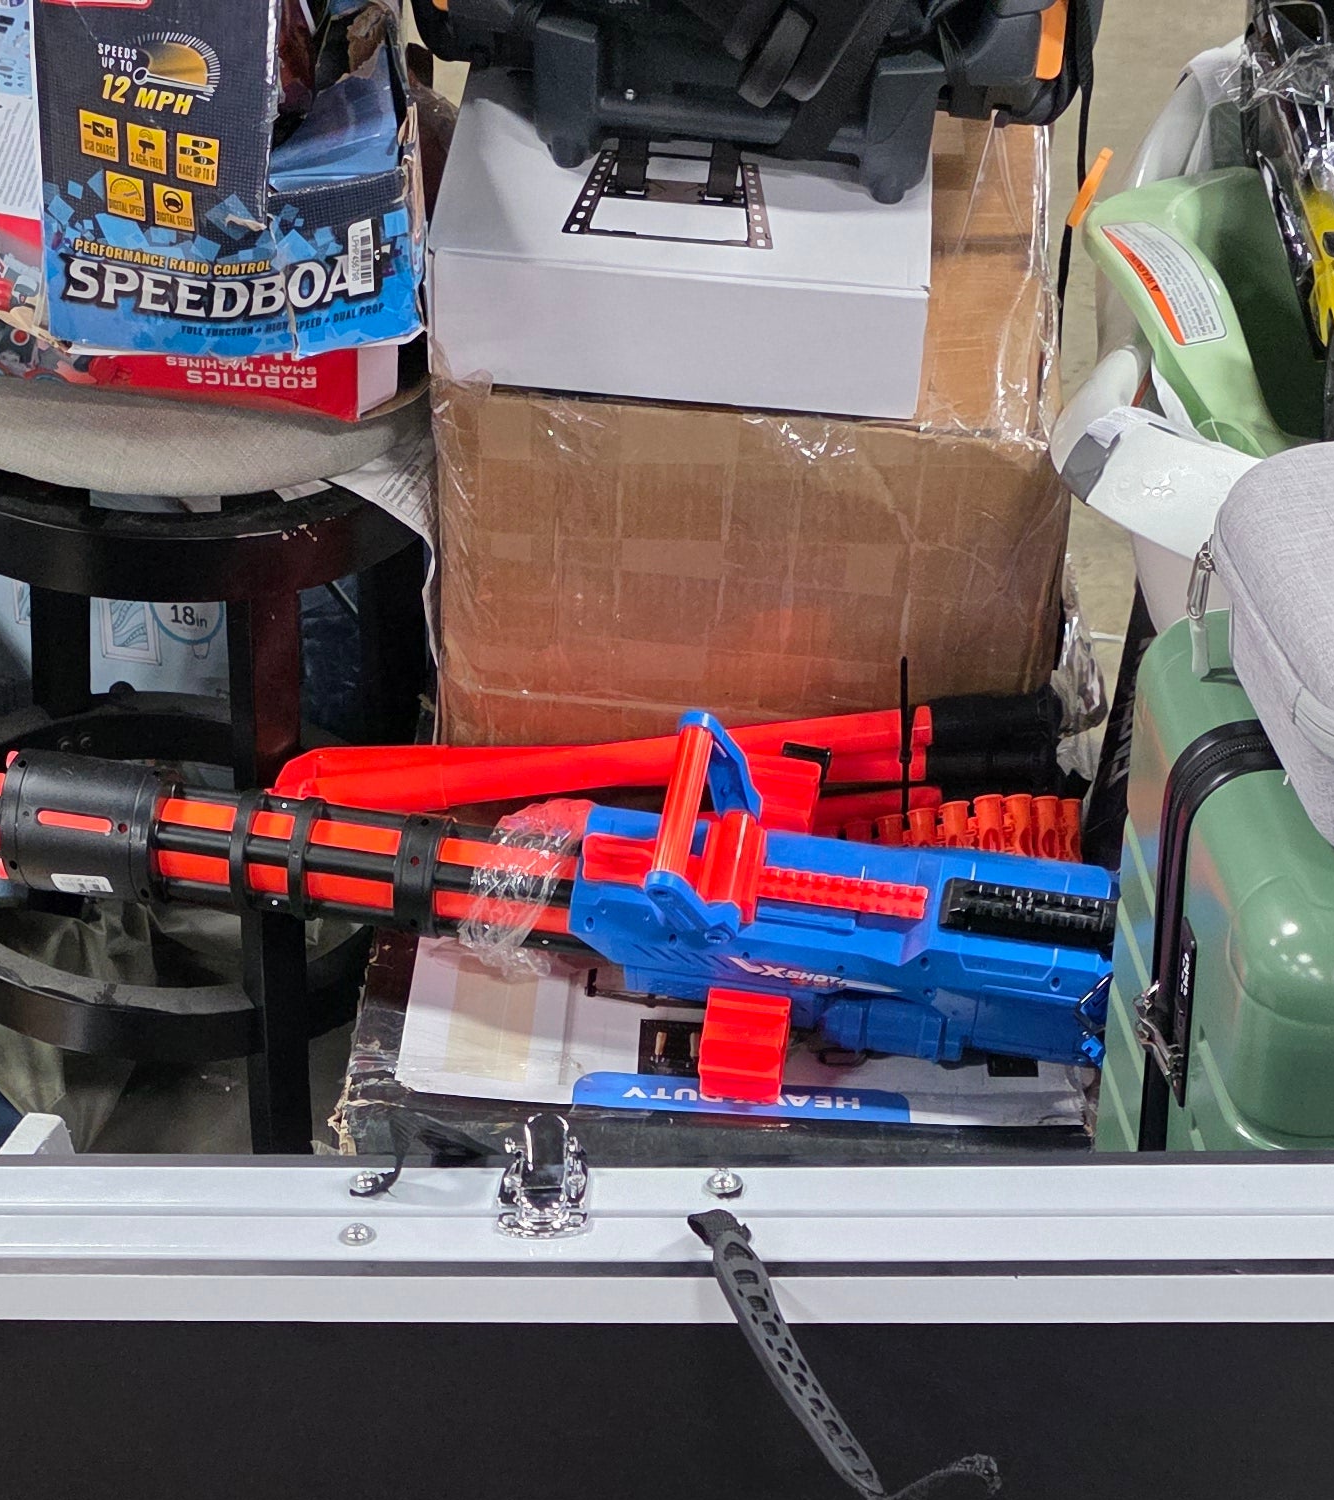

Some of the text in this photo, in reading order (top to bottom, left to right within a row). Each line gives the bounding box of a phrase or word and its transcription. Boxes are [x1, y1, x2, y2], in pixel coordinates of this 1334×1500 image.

[97, 42, 138, 61] SPEEDS
[101, 56, 133, 73] UP TO
[102, 73, 194, 116] 12 MPH
[95, 141, 117, 158] CHARGE
[178, 163, 193, 176] RACE
[194, 166, 201, 178] UP
[202, 168, 210, 180] TO
[108, 199, 145, 217] DIGITAL SPEED
[156, 210, 193, 228] DIGITAL STEER
[74, 239, 271, 277] PERFORMANCE RADIO CONTROL
[66, 244, 391, 319] SPEEDBOA
[205, 325, 254, 337] FUNCTION
[333, 311, 357, 324] DUAL
[359, 303, 385, 319] PROP
[166, 356, 317, 376] SMART MACHINES
[186, 369, 317, 389] ROBOTICS
[170, 604, 208, 630] 18in
